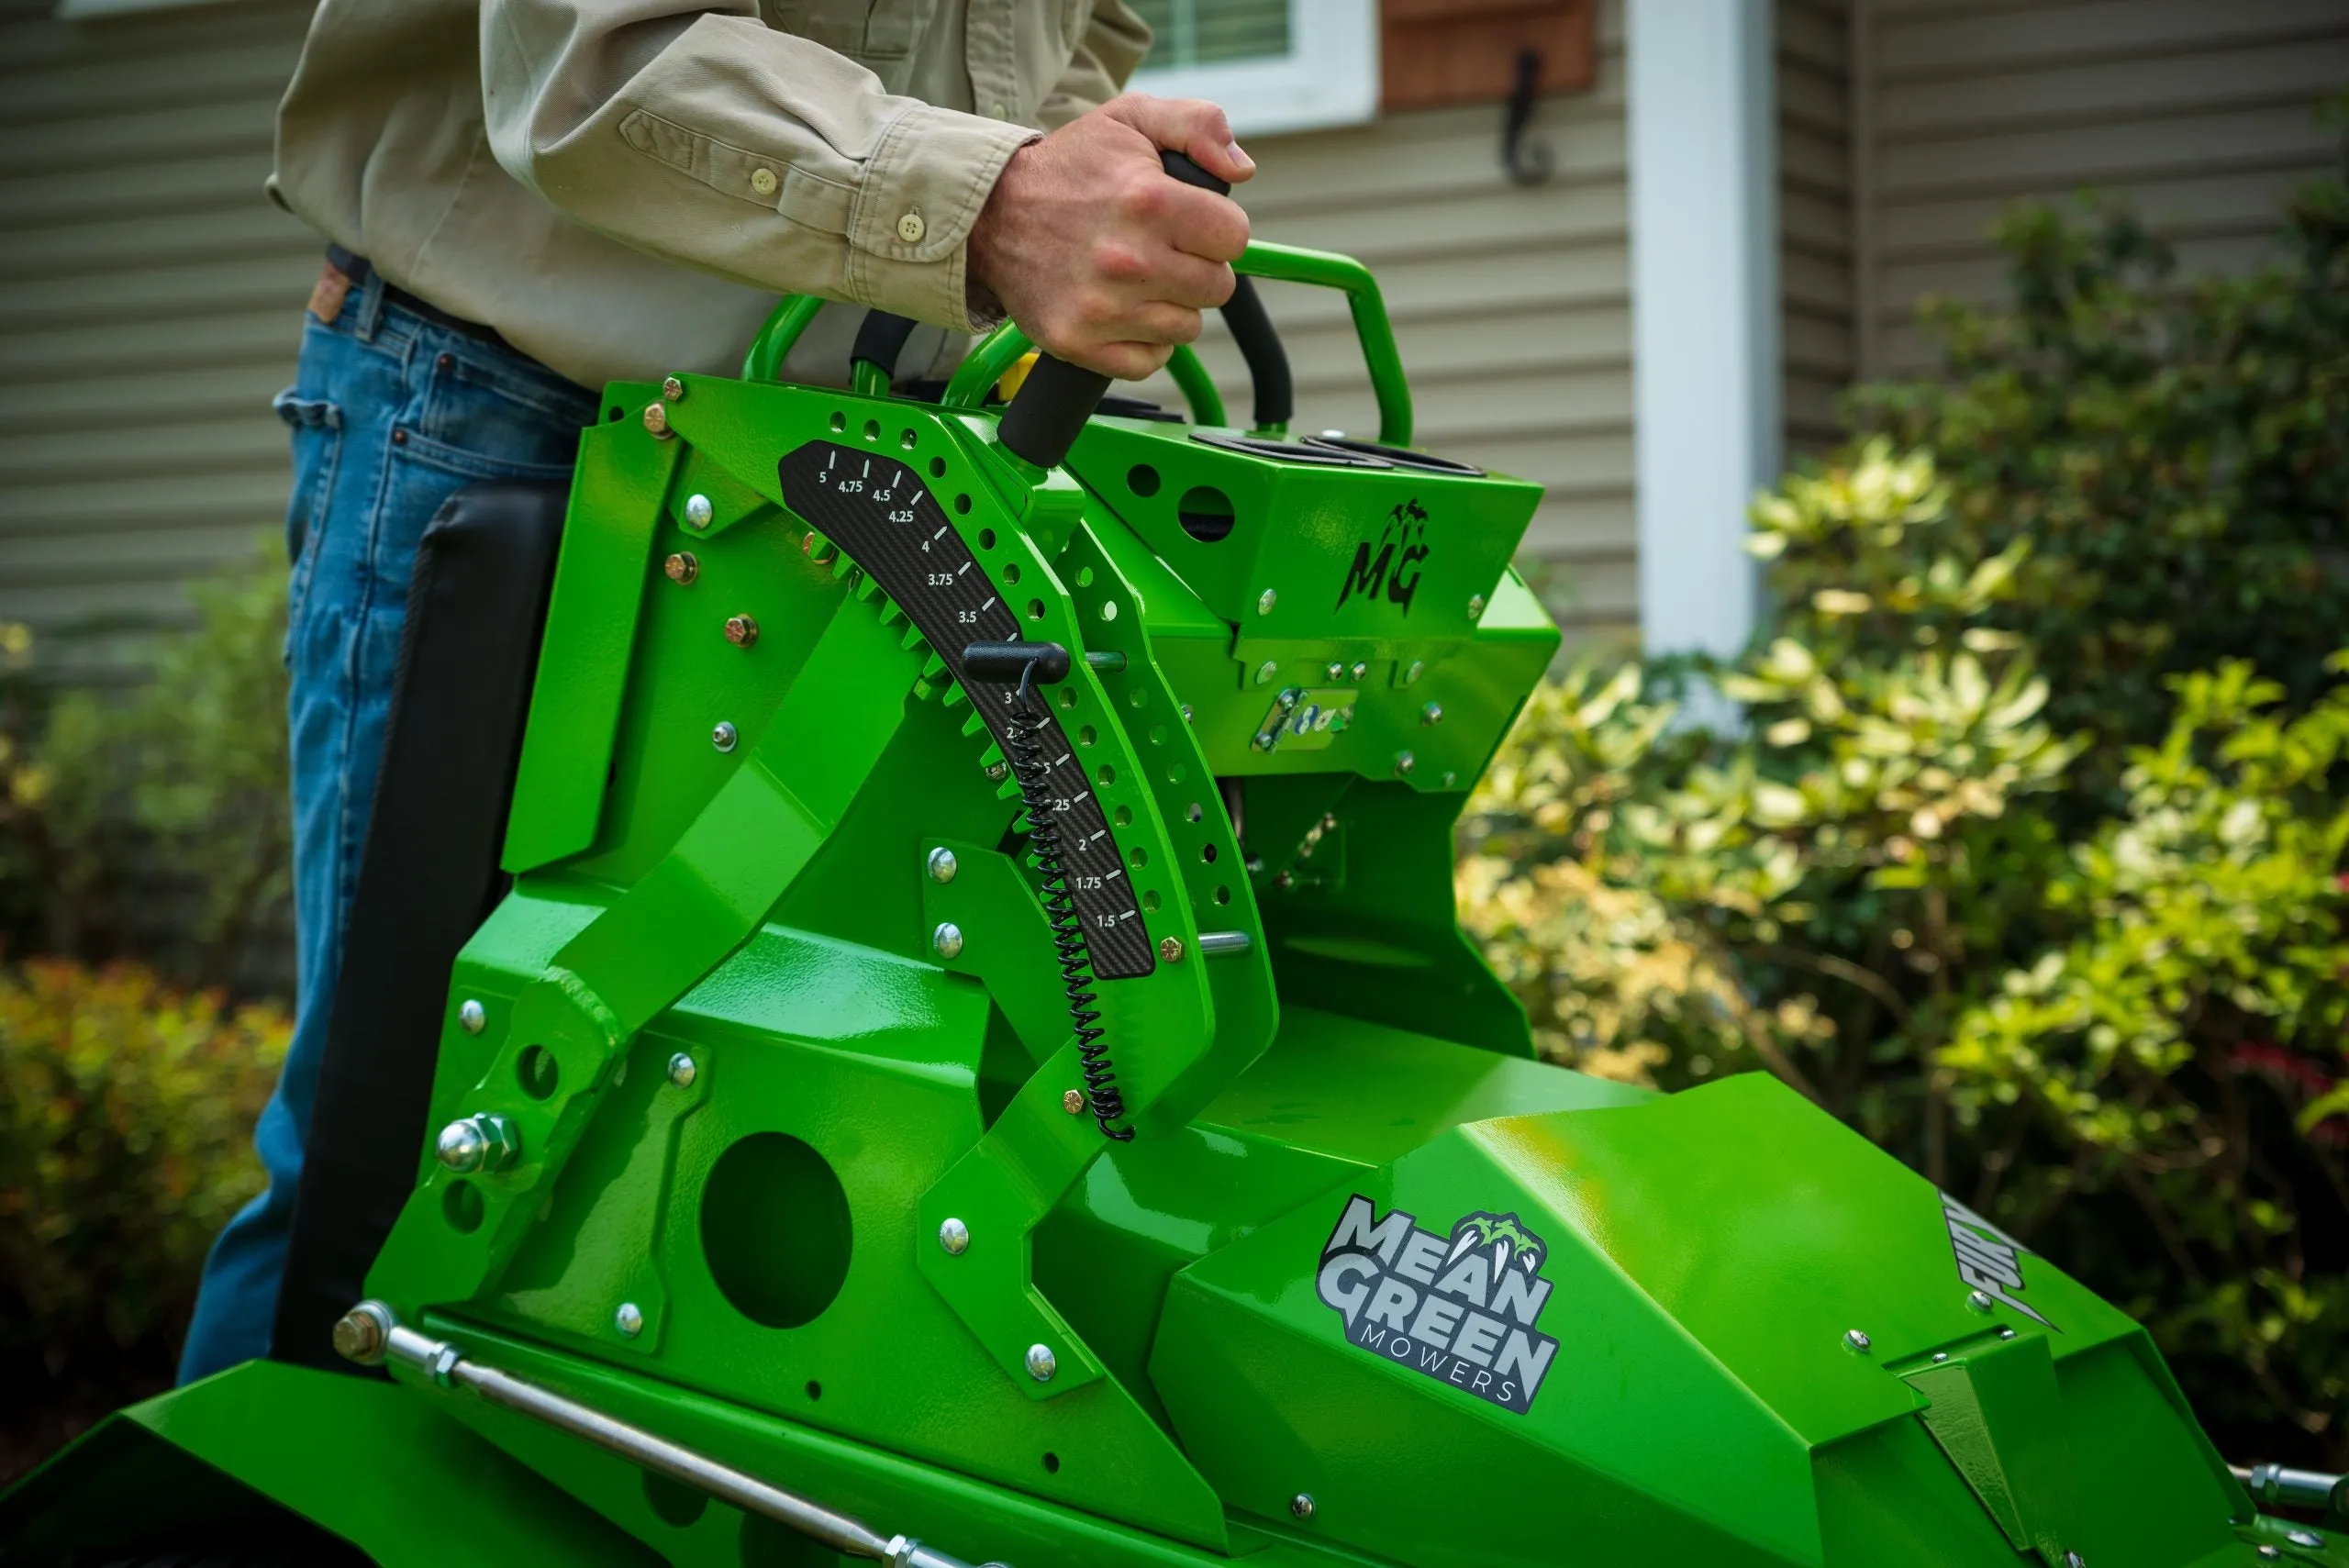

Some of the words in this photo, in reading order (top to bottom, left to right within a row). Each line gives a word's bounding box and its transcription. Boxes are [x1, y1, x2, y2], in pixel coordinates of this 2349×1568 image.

[818, 471, 827, 484] 5
[838, 480, 863, 493] 4.75
[873, 489, 891, 502] 4.5
[888, 510, 914, 523] 4.25
[921, 540, 930, 553] 4
[928, 573, 953, 585] 3.75
[1335, 542, 1430, 617] MG
[958, 611, 977, 624] 3.5
[1005, 692, 1013, 705] 3
[1078, 839, 1087, 851] 2
[1075, 876, 1102, 889] 1.75
[1097, 915, 1116, 928] 1.5
[1325, 1196, 1552, 1326] MEAN
[1319, 1253, 1556, 1403] GREEN
[1360, 1324, 1516, 1402] MOWERS
